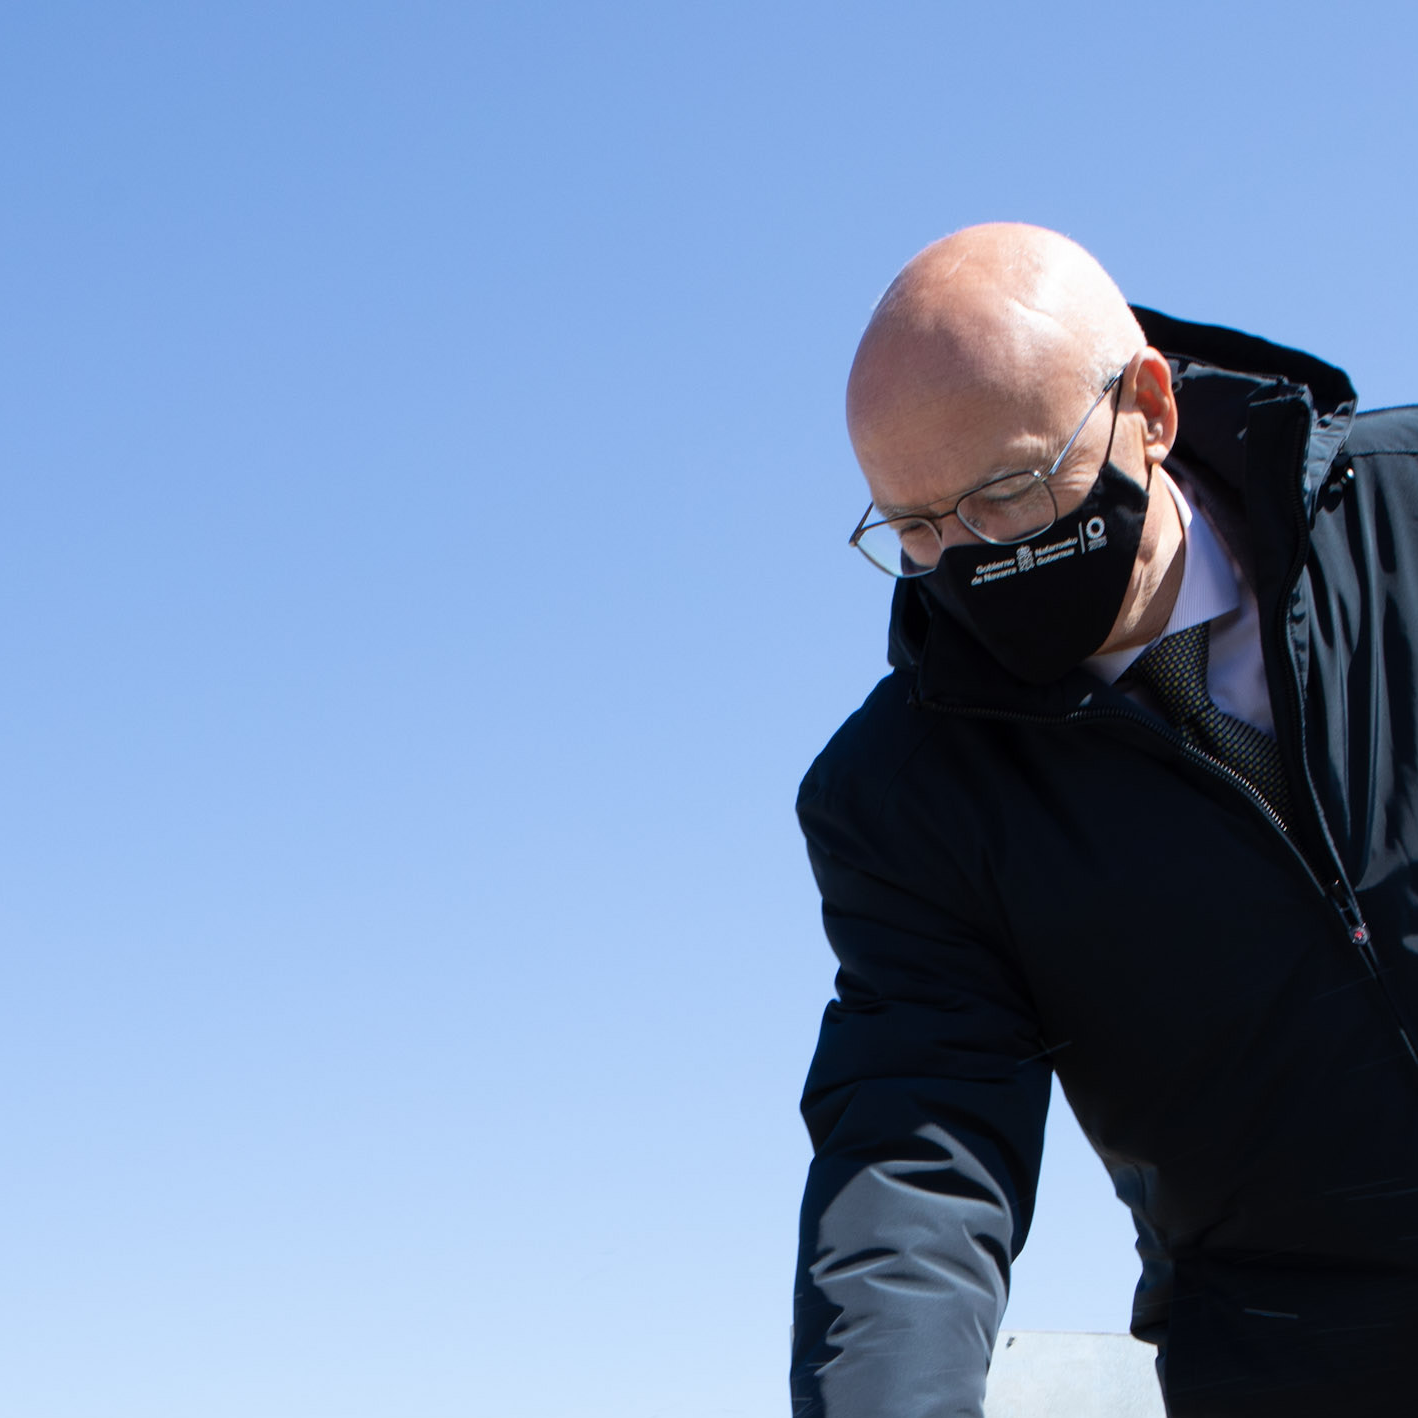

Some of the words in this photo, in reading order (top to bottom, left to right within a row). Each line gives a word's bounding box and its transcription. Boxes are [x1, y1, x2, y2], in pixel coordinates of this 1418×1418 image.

[975, 558, 1015, 575] Gobierno
[971, 575, 983, 586] de
[983, 567, 1017, 583] Navarra
